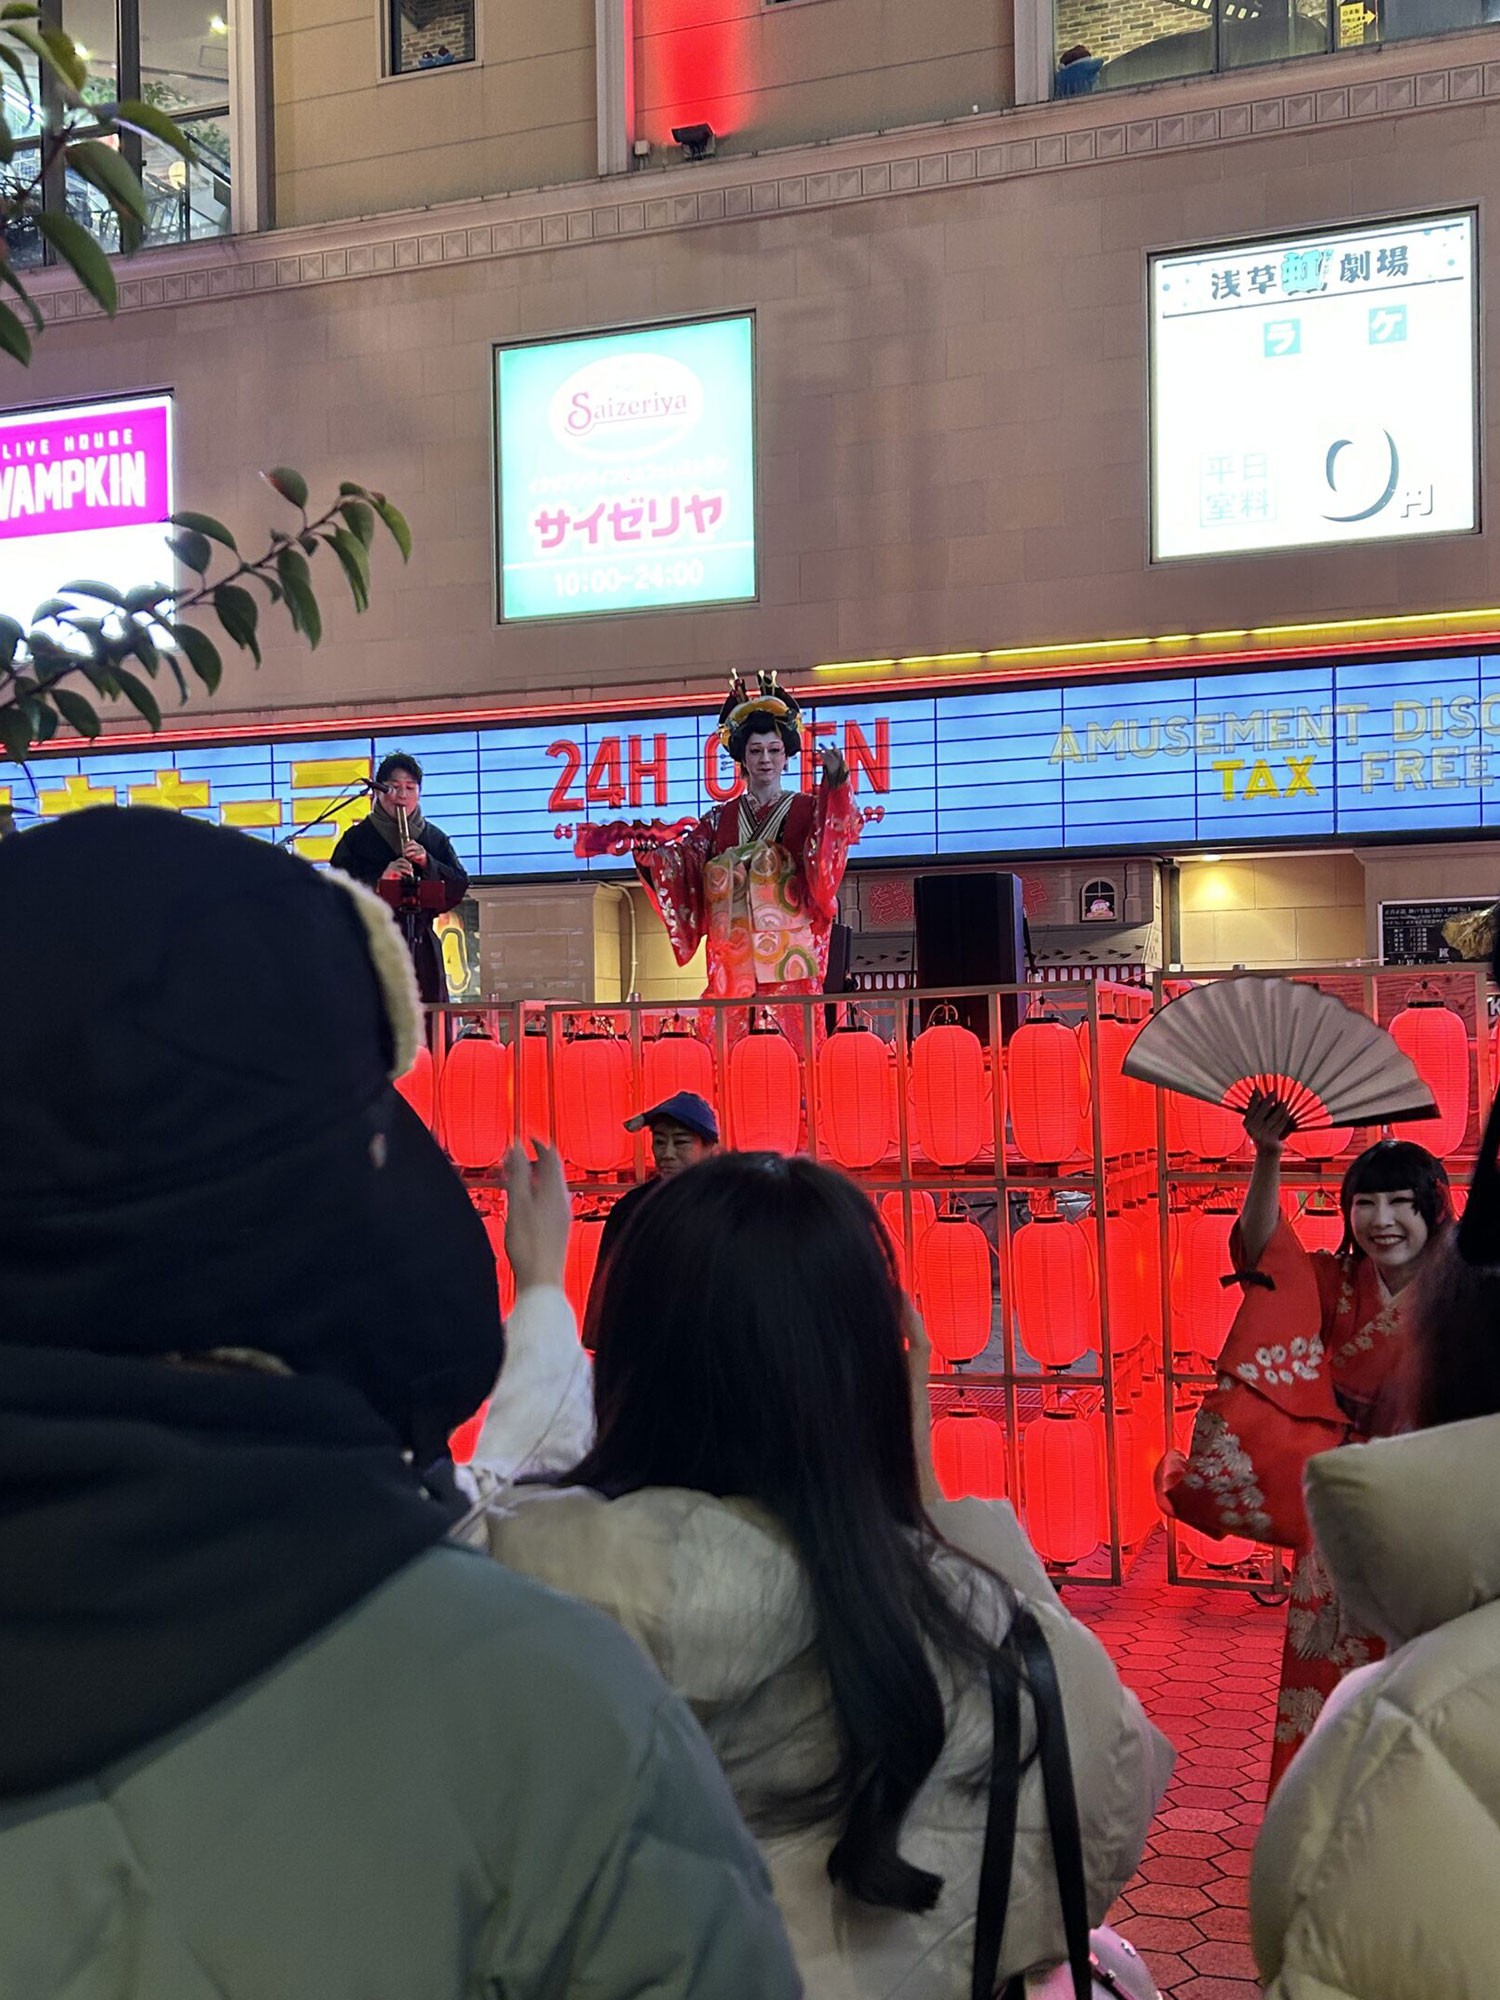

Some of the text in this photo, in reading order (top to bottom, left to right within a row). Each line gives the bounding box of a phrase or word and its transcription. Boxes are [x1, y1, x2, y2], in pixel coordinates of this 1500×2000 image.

[567, 391, 687, 430] Saizeriya
[3, 428, 134, 459] LIVE HOUSE
[534, 494, 723, 549] サイゼリヤ
[1048, 702, 1369, 766] AMUSEMENT
[546, 717, 891, 813] 24H OEN
[1212, 744, 1494, 801] TAX FREE
